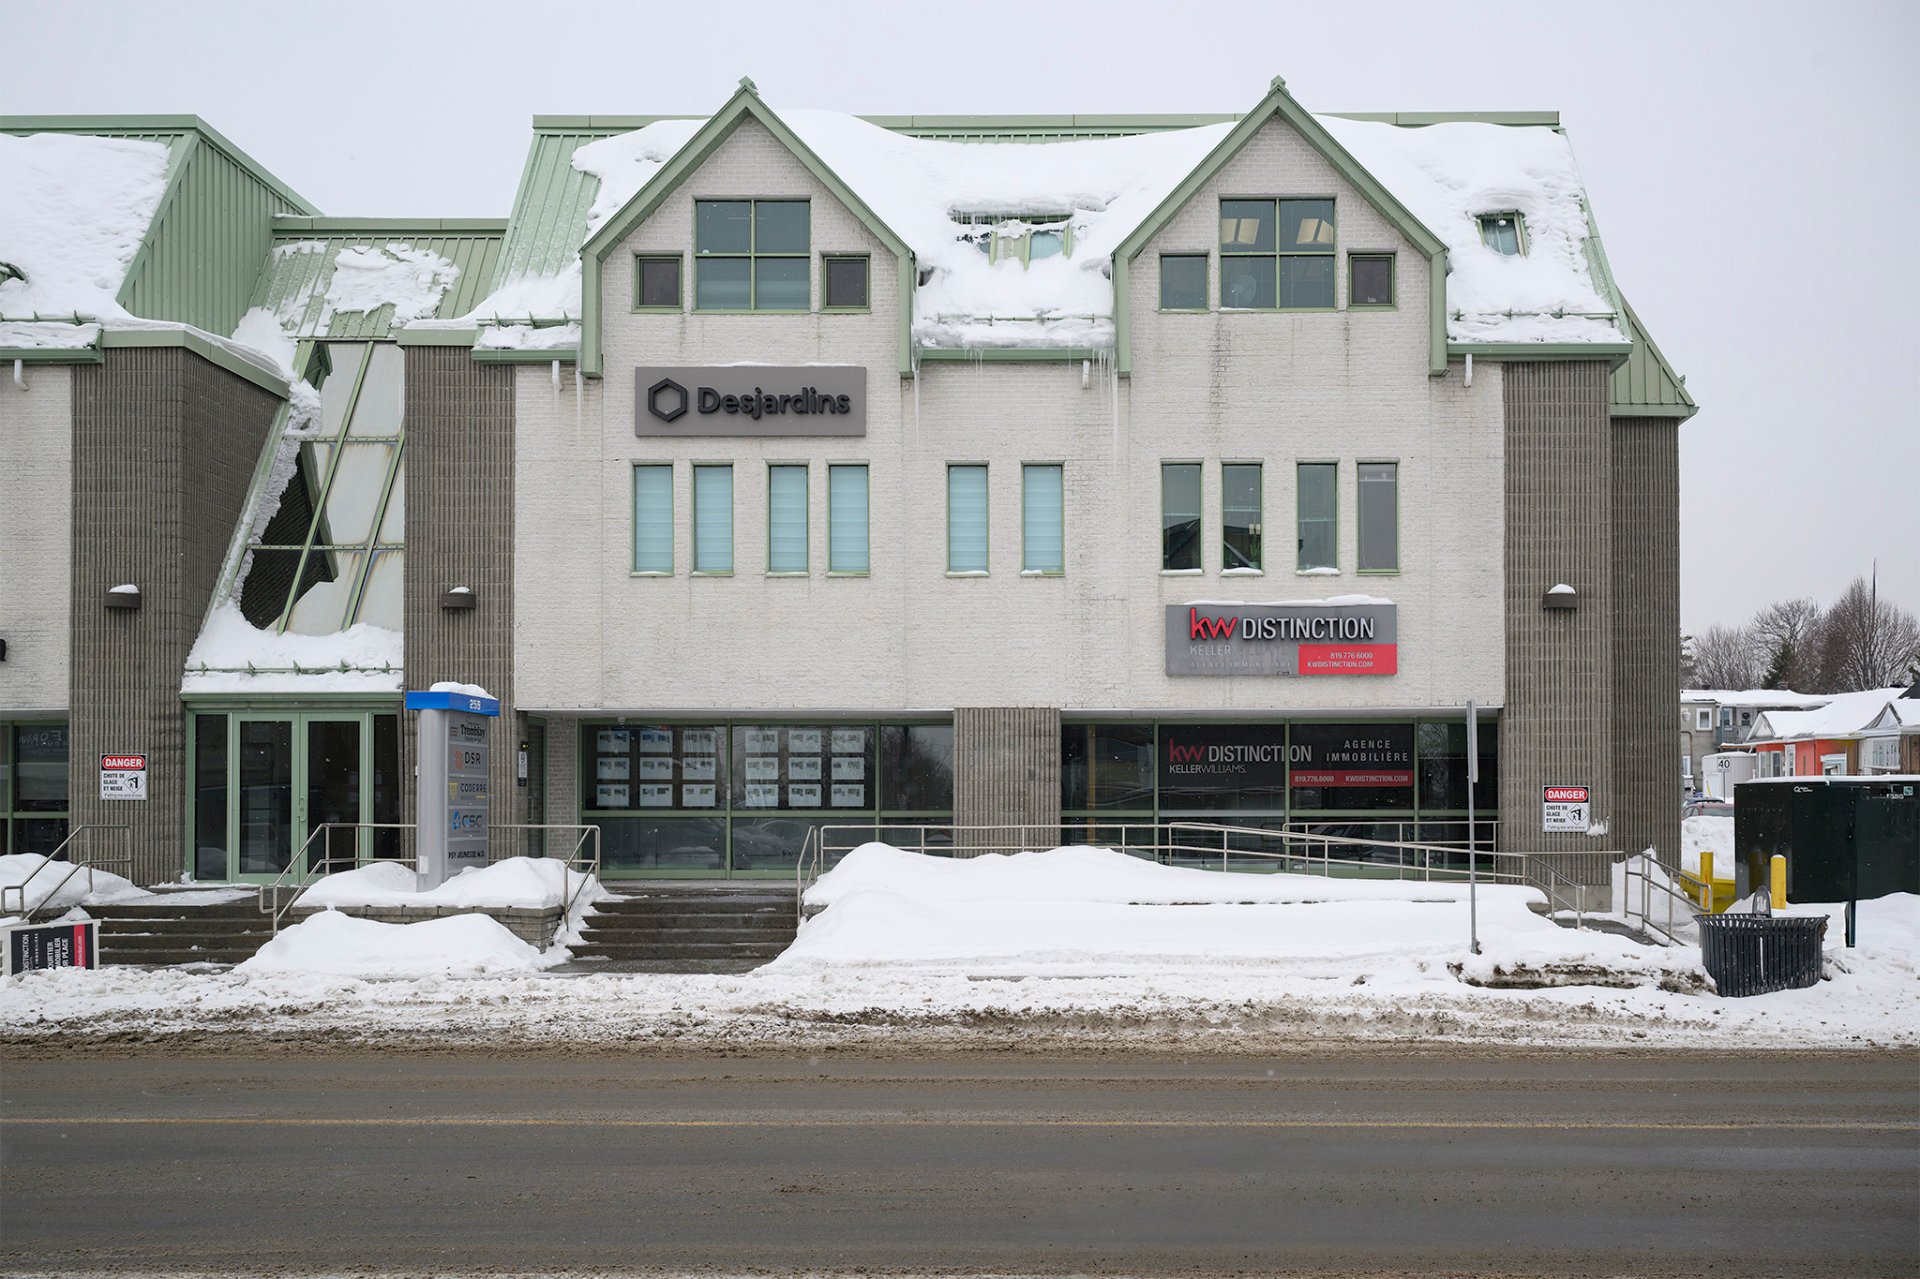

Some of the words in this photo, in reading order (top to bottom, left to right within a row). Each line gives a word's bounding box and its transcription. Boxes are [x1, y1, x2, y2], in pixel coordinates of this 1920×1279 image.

[697, 387, 850, 419] Desjardins
[1190, 607, 1238, 640] kw
[1242, 617, 1375, 640] DISTINCTION
[1190, 645, 1231, 656] KELLER
[470, 699, 481, 710] 259
[1169, 738, 1205, 762] kw
[1209, 745, 1312, 762] DISTINCTION
[1344, 740, 1391, 750] AGENCE
[465, 752, 481, 765] DSR
[1326, 751, 1408, 762] IMMOBILIÈRE
[105, 759, 142, 767] DANGER
[1718, 759, 1731, 769] 40
[461, 783, 487, 793] CODERRE
[1548, 790, 1585, 799] DANGER
[22, 934, 30, 971] DISTINCTION
